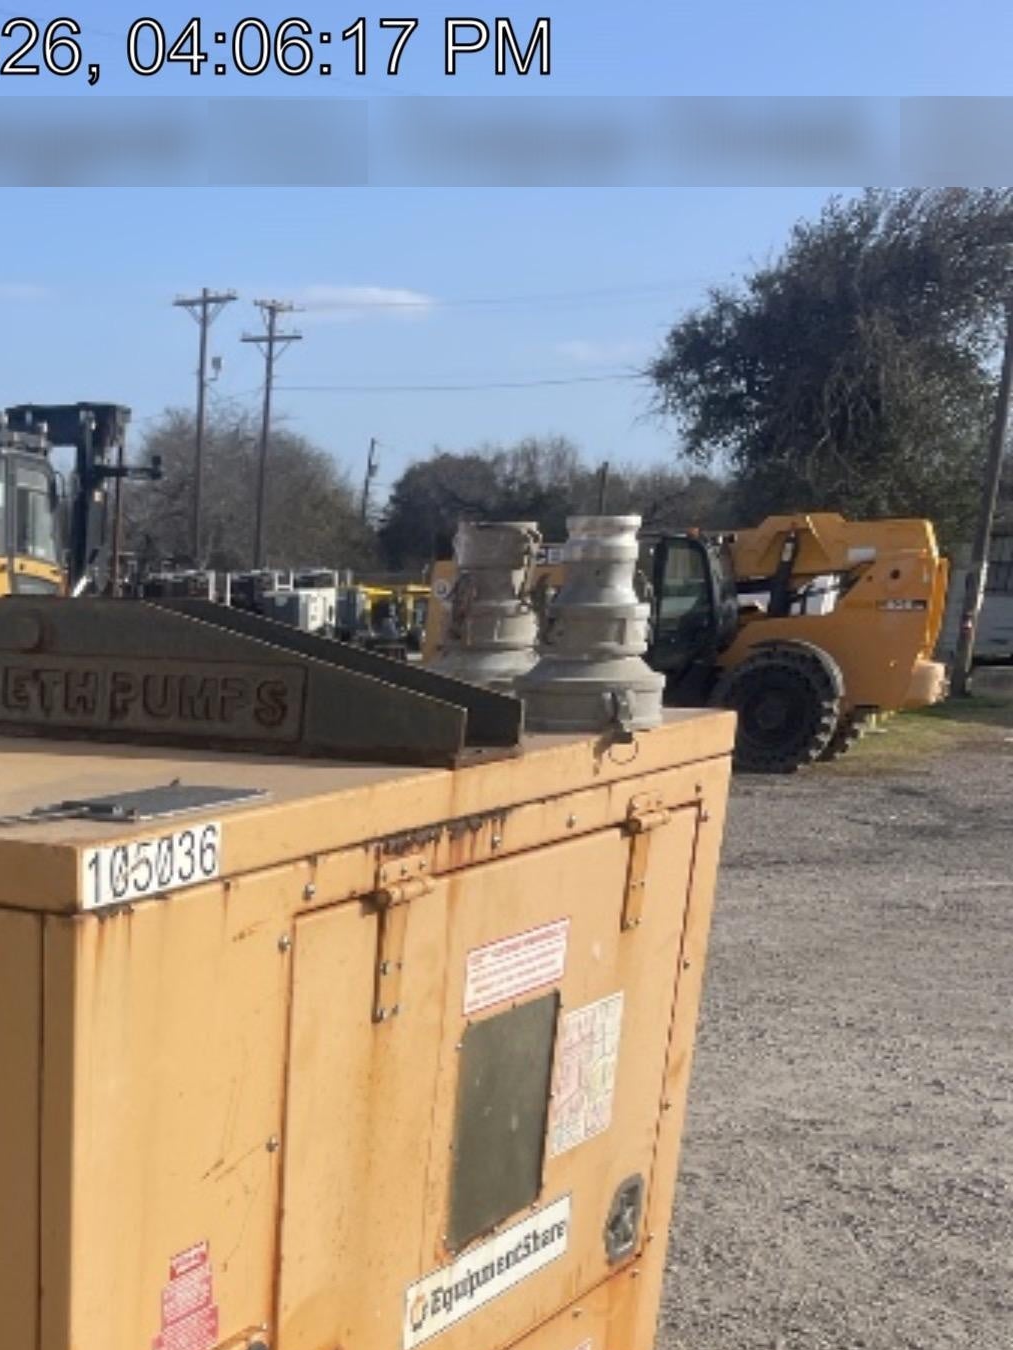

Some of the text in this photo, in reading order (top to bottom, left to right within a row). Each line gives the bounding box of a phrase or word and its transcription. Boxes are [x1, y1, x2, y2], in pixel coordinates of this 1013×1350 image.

[109, 672, 289, 728] PUMPS
[88, 824, 217, 904] 105036
[431, 1220, 567, 1317] EquipmentShare
